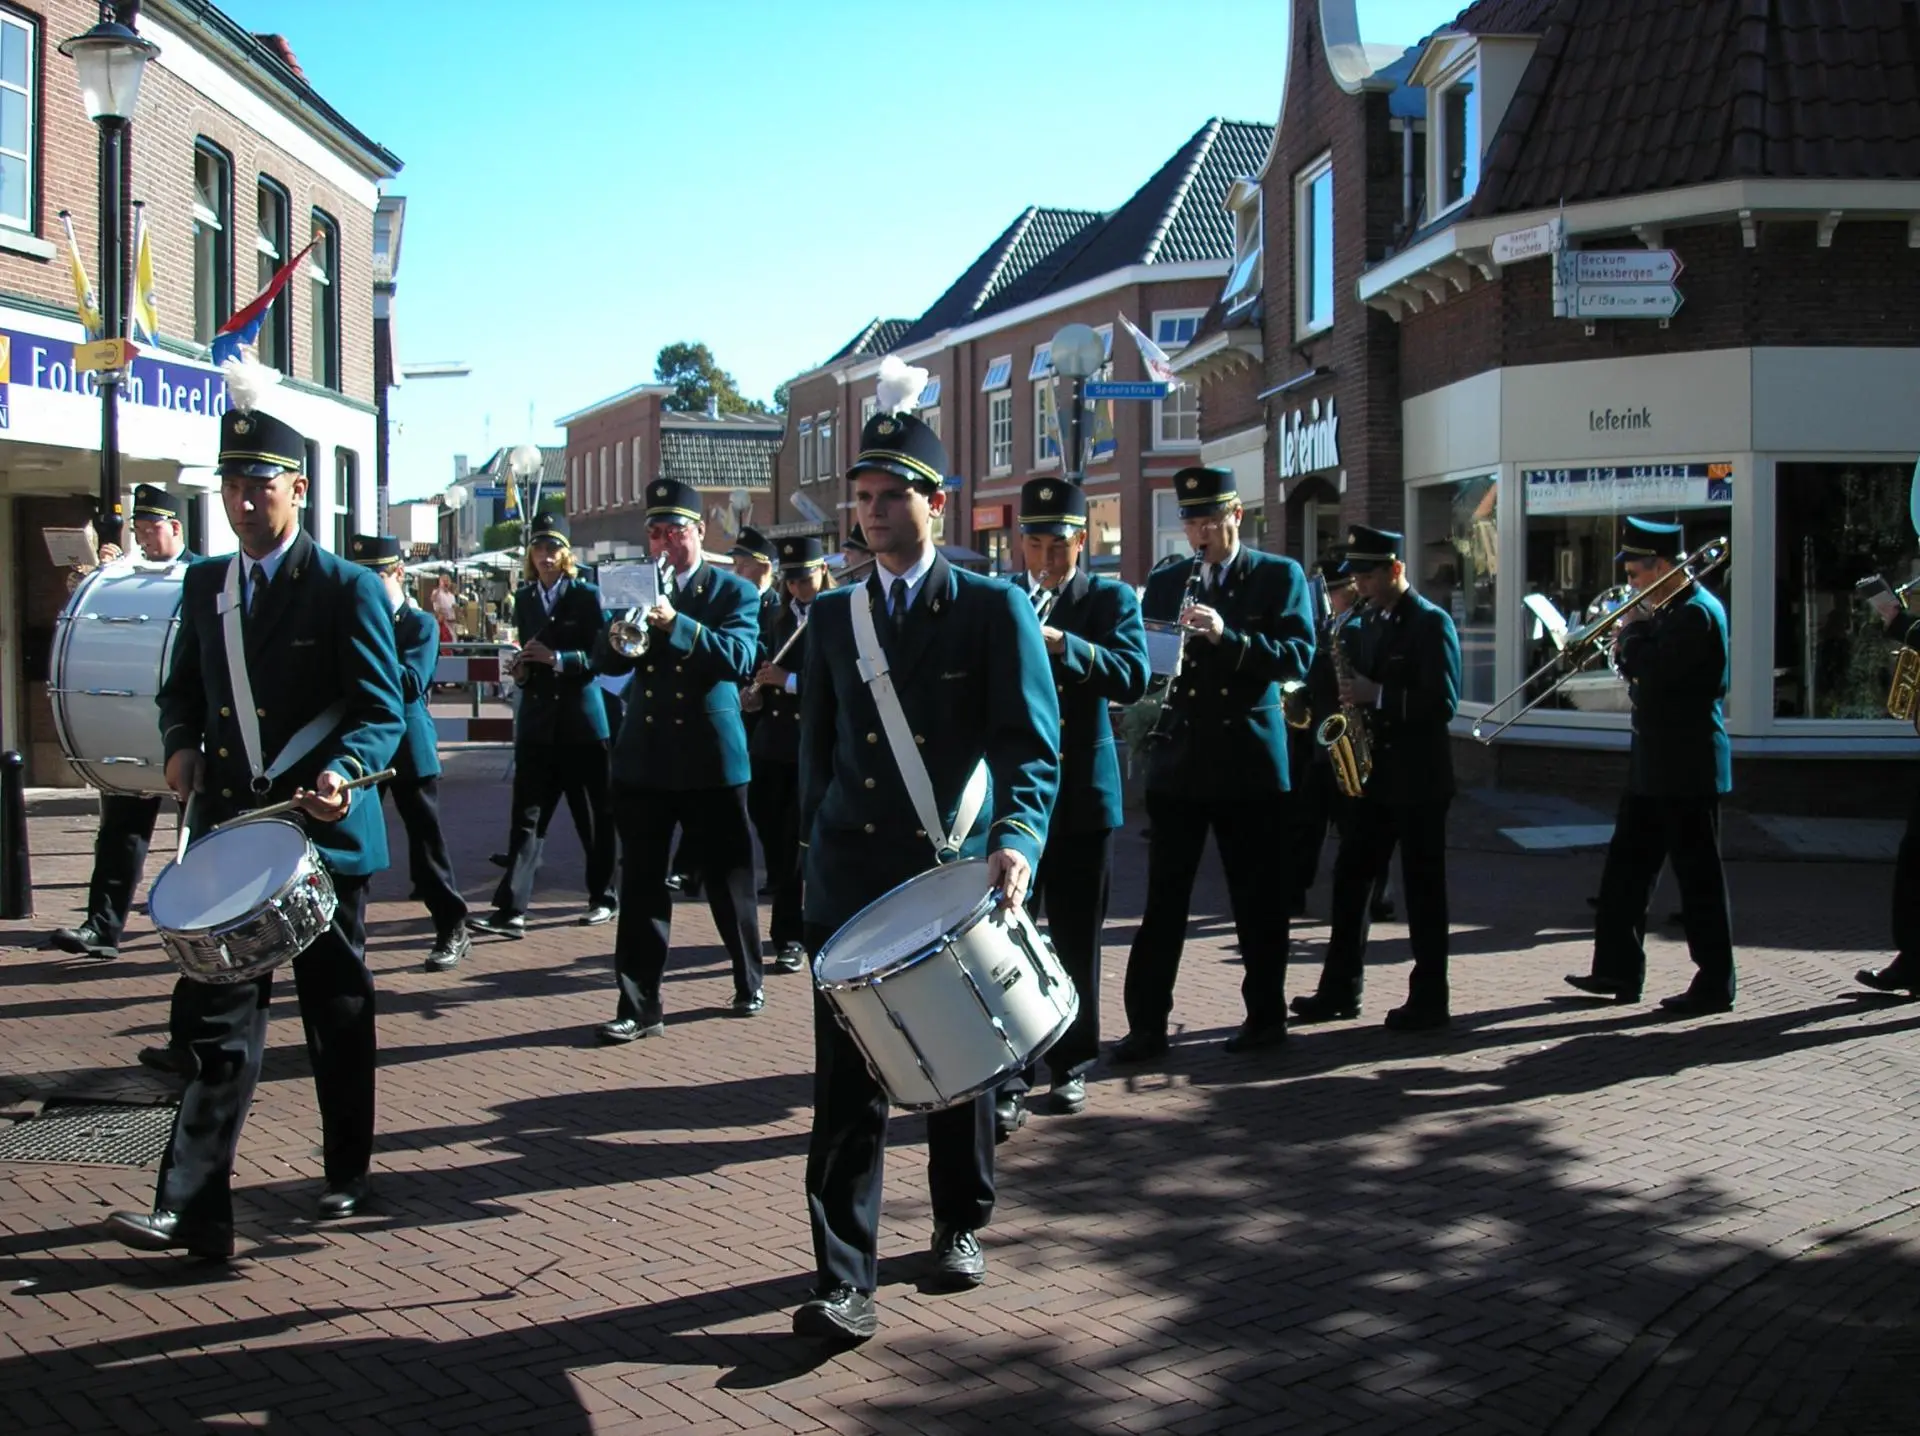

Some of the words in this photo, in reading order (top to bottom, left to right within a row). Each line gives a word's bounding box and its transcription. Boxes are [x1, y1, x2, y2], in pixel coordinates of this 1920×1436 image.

[1581, 255, 1626, 265] Beckum
[1581, 269, 1653, 281] Haaksbergen
[157, 367, 226, 418] beeld
[1589, 406, 1652, 431] leferink
[1279, 393, 1340, 479] leferink
